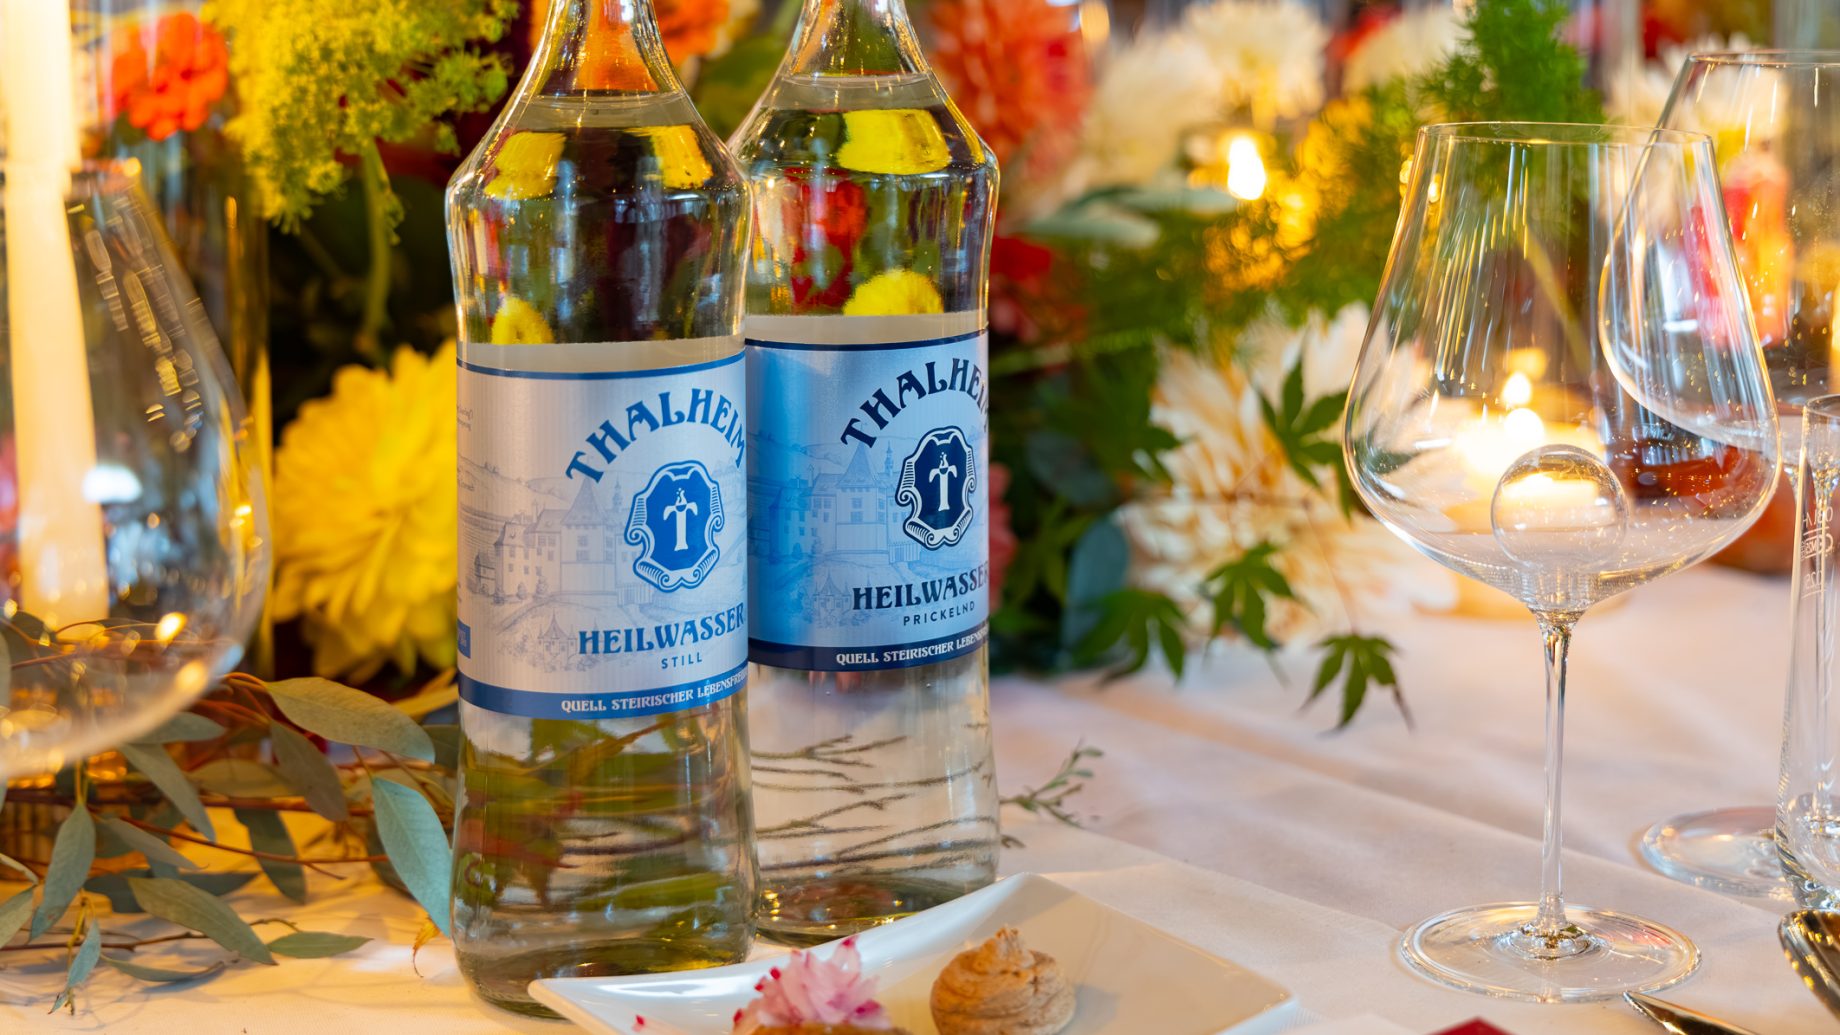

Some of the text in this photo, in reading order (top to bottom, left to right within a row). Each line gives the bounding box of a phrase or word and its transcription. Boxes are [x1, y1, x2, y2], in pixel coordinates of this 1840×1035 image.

[565, 388, 745, 484] THALHEIM
[903, 600, 975, 626] PRICKELND
[578, 602, 745, 655] HEILWASSER
[661, 651, 703, 670] STILL
[836, 653, 879, 666] QUELL
[883, 641, 954, 663] STEIRISCHER
[561, 700, 607, 713] QUELL
[611, 689, 694, 711] STEIRISCHER
